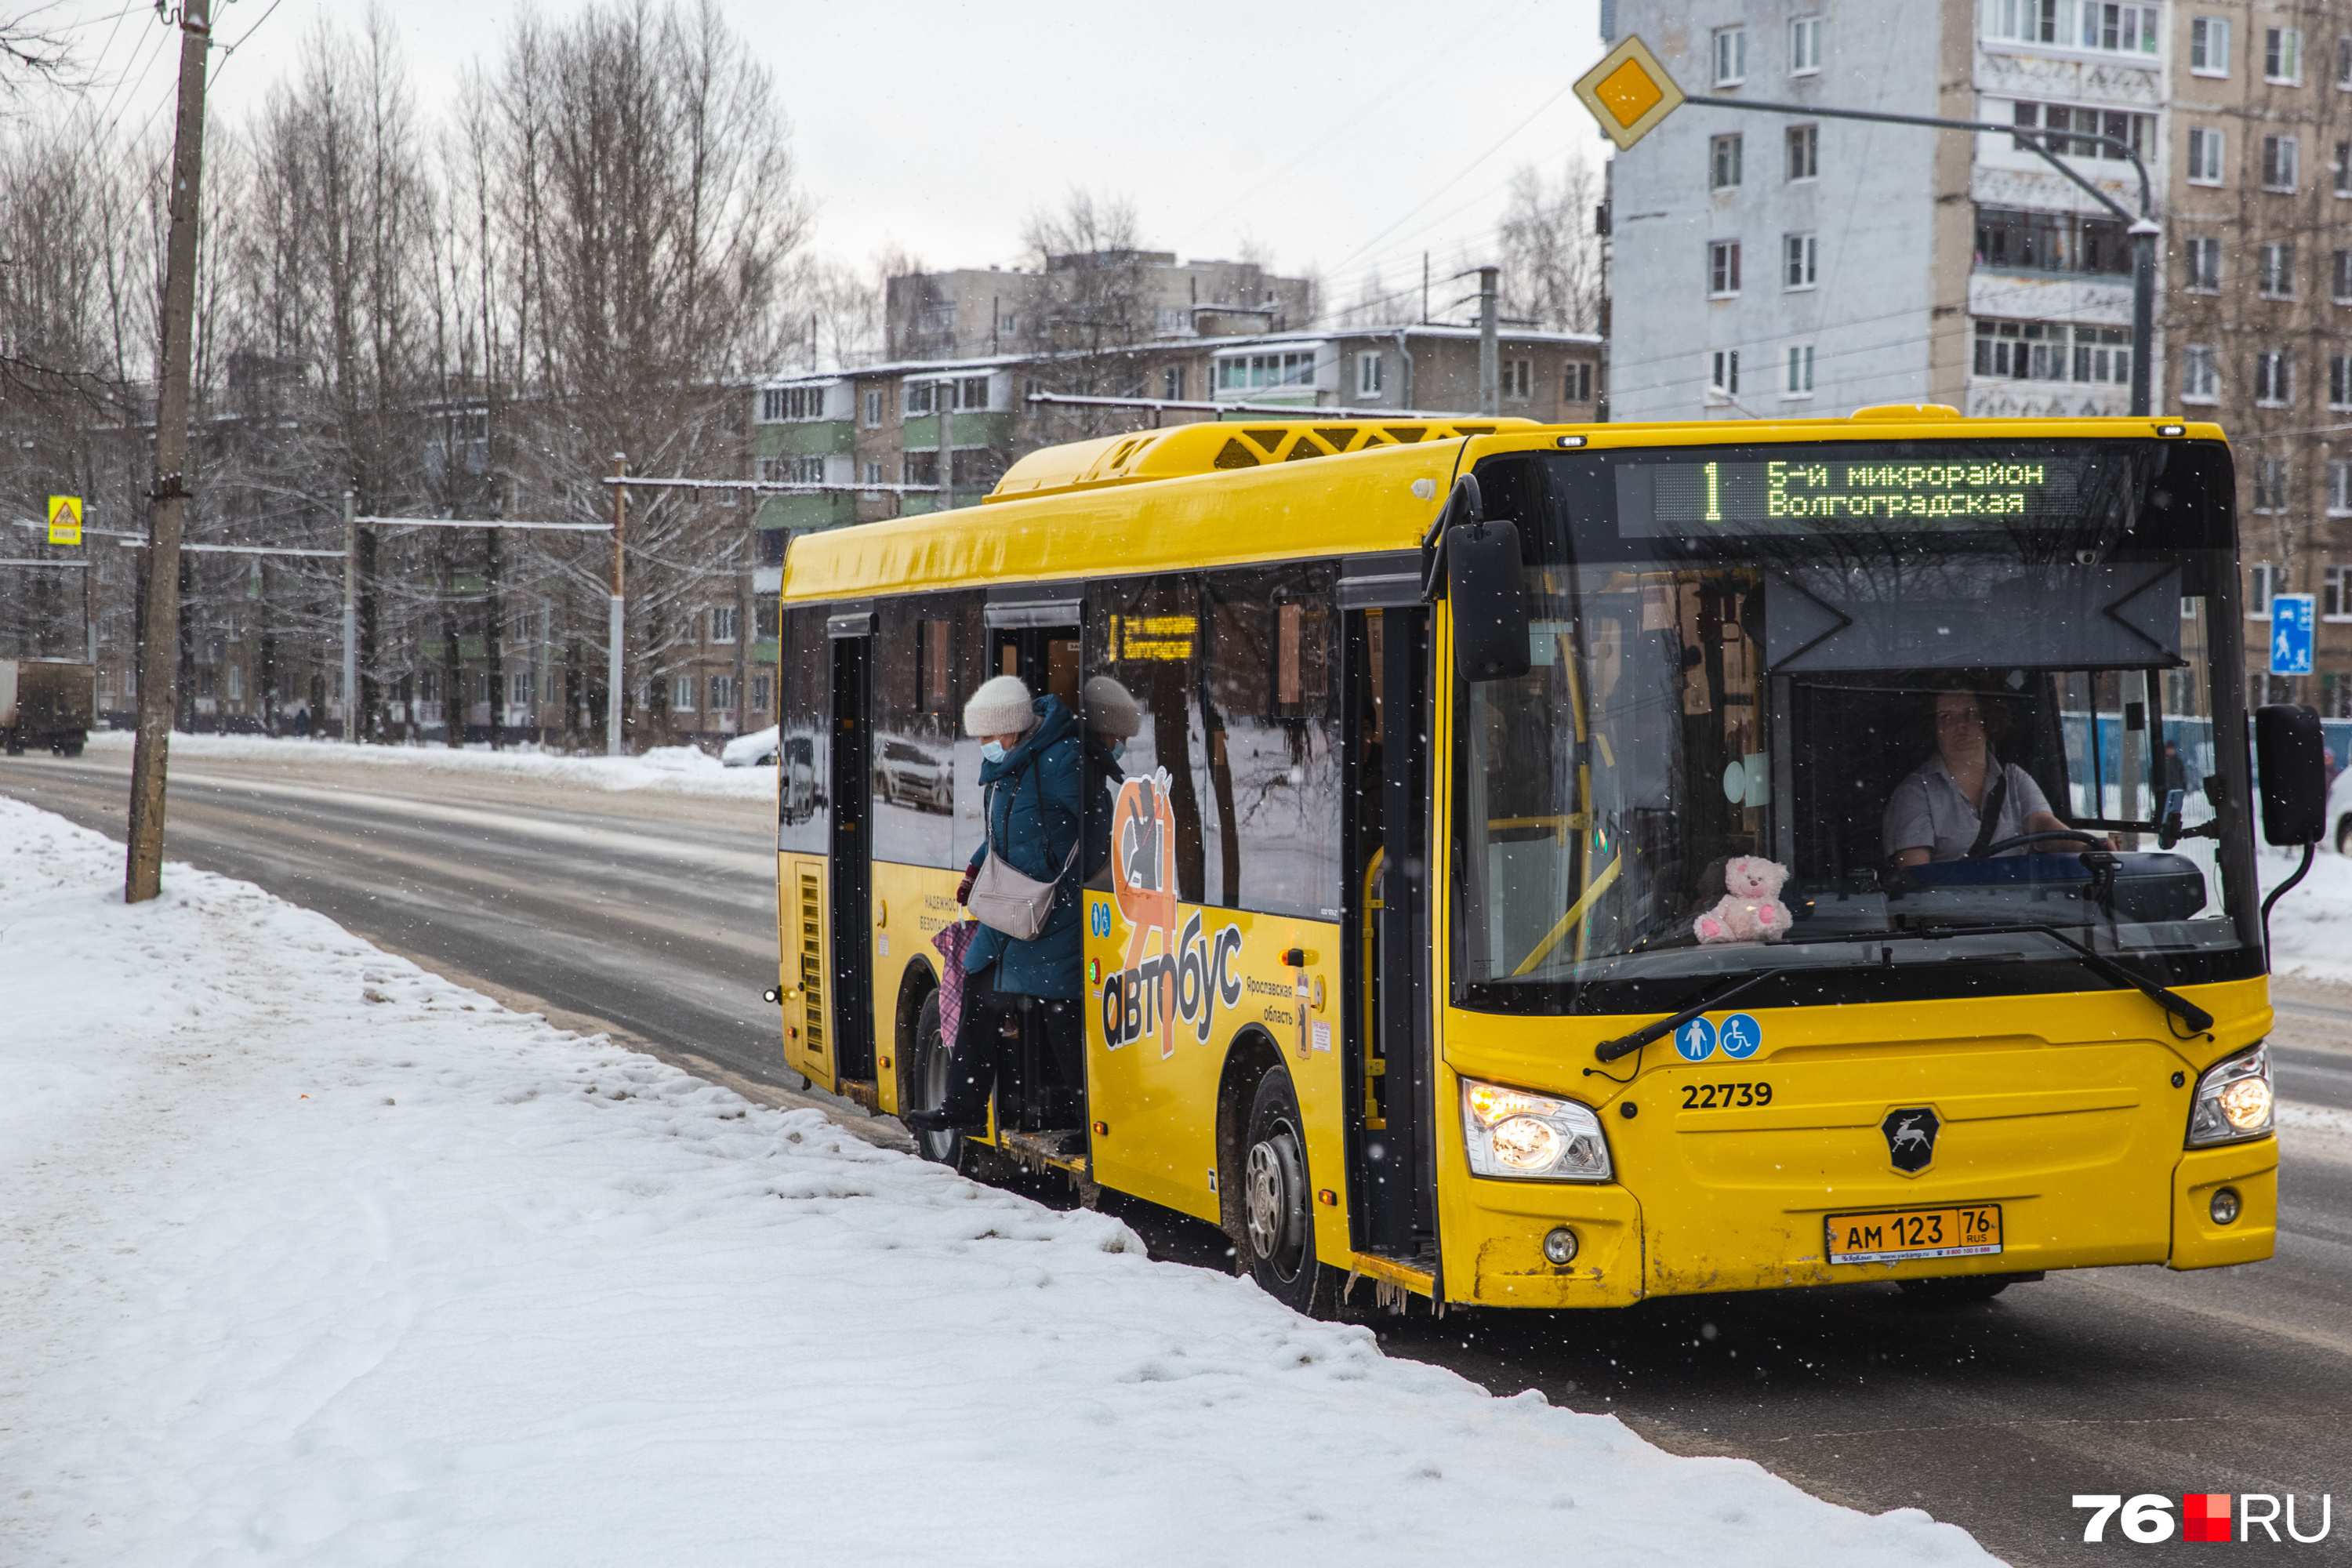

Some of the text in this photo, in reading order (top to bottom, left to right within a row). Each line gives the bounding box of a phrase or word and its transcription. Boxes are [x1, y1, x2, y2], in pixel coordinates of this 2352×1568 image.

[1769, 461, 2043, 488] 5-й микрорайон
[1705, 462, 1721, 521] 1
[1769, 490, 2024, 518] Волгоградская
[1247, 975, 1292, 998] Ярославская
[1264, 1005, 1293, 1025] область
[1681, 1082, 1773, 1109] 22739
[1891, 1216, 1943, 1246] 123
[1962, 1210, 1990, 1233] 76
[1966, 1234, 1987, 1243] RUS
